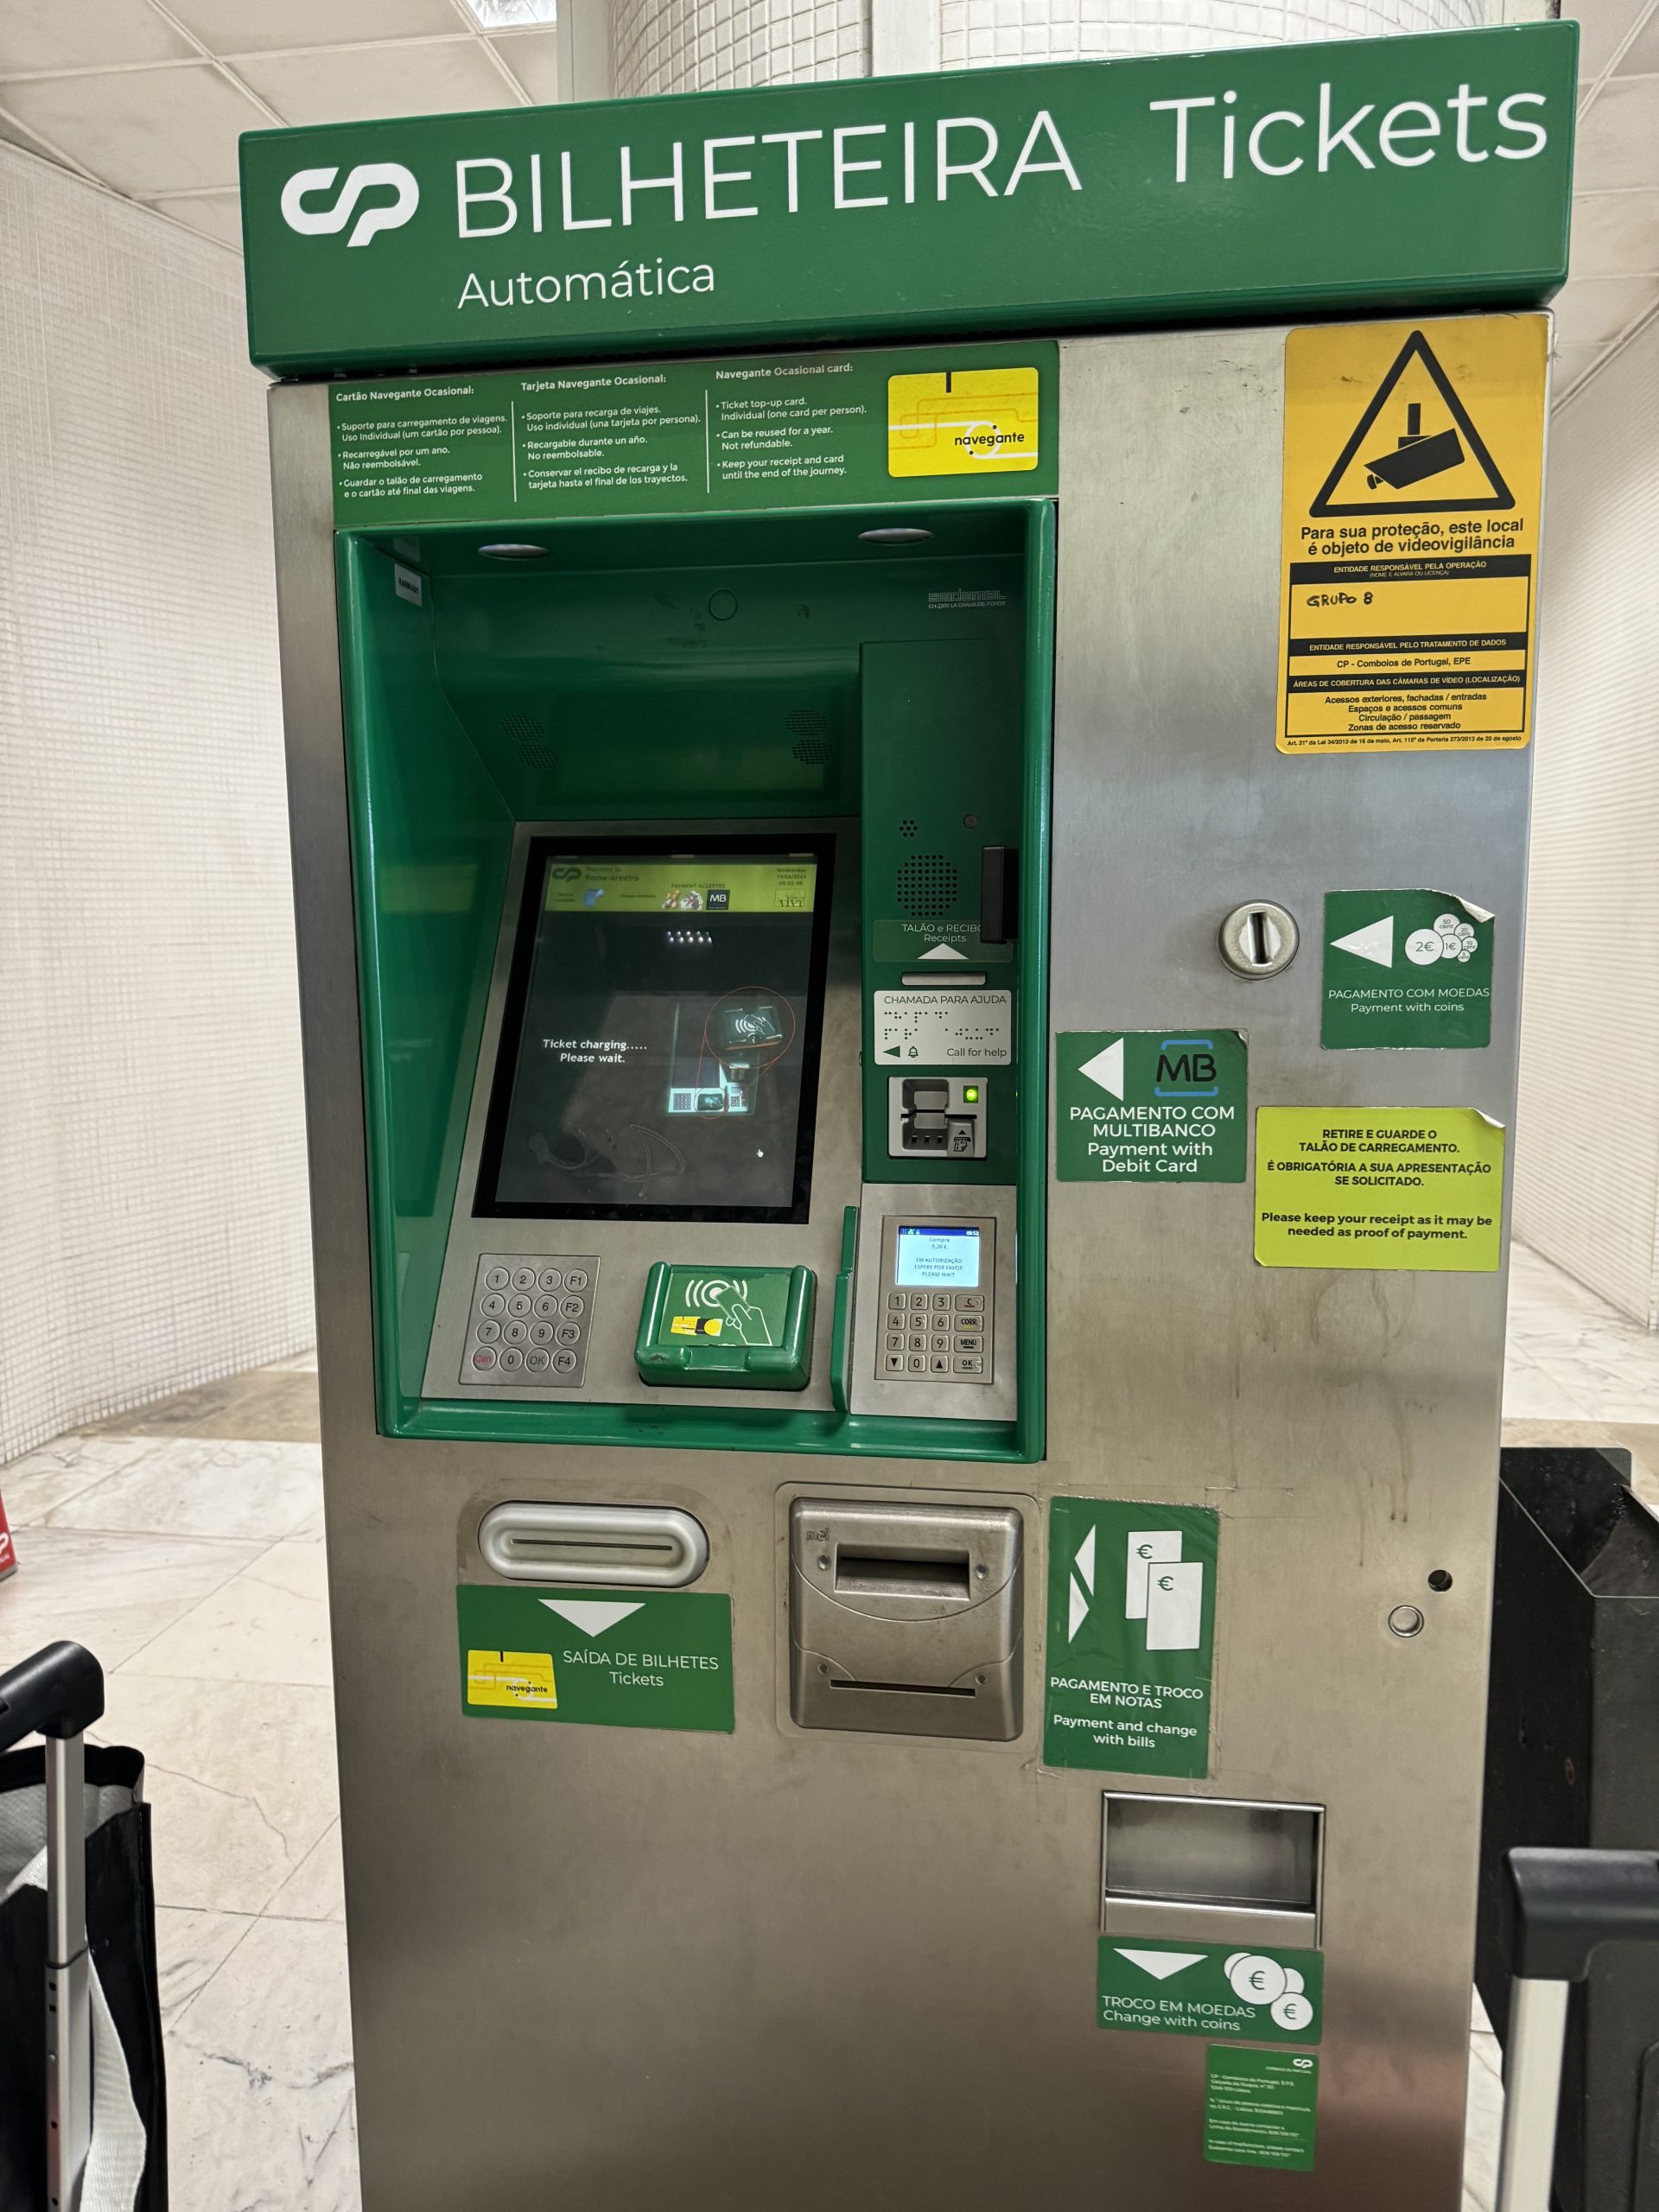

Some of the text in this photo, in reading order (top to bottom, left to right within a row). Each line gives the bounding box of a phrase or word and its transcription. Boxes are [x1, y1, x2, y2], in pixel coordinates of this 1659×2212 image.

[455, 108, 1083, 238] BILHETEIRA
[1149, 82, 1548, 183] Tickets
[458, 257, 714, 308] Automática
[716, 363, 853, 380] Navegante Ocasional card:
[521, 374, 666, 391] Tarjeta Navegante Ocasional:
[336, 385, 474, 402] Cartão Navegante Ocasional:
[721, 397, 807, 410] Ticket top-up card.
[341, 423, 375, 432] Suporte
[377, 422, 395, 430] para
[397, 417, 457, 429] carregamento
[472, 416, 507, 424] viagens.
[528, 439, 576, 450] Recargable
[578, 437, 613, 446] durante
[628, 435, 647, 444] año.
[741, 439, 792, 449] refundable.
[955, 432, 1024, 447] navegante
[343, 448, 397, 459] Recarregável
[399, 449, 413, 458] por
[543, 448, 604, 459] reembolsable.
[343, 458, 421, 470] Não reembolsável.
[722, 454, 843, 469] Keep your receipt and card
[722, 467, 847, 480] until the end of the journey.
[1301, 518, 1523, 539] Para sua proteção, este local
[1308, 535, 1515, 557] é objeto de videovigilância
[1446, 561, 1486, 569] OPERAÇÃO
[924, 934, 966, 944] Receipts
[1415, 941, 1434, 952] 2€
[884, 995, 1007, 1004] CHAMADA PARA AJUDA
[1329, 988, 1490, 999] PAGAMENTO COM MOEDAS
[1351, 1002, 1465, 1014] Payment with coins
[543, 1039, 577, 1048] Ticket
[560, 1053, 625, 1063] Please wait.
[947, 1047, 1007, 1058] Call for help
[1156, 1054, 1217, 1082] MB
[1071, 1106, 1234, 1120] PAGAMENTO COM
[1094, 1124, 1216, 1137] MULTIBANCO
[1323, 1129, 1437, 1139] RETIRE E GUARDE O
[1089, 1141, 1212, 1158] Payment with
[1299, 1140, 1459, 1153] TALÃO DE CARREGAMENTO.
[1103, 1159, 1197, 1173] Debit Card
[1335, 1176, 1424, 1185] SE SOLICITADO.
[1287, 1226, 1334, 1236] needed
[1355, 1228, 1389, 1239] proof
[1391, 1228, 1406, 1237] of
[1408, 1230, 1467, 1240] payment.
[570, 1276, 582, 1286] F1
[565, 1302, 578, 1313] F2
[562, 1329, 575, 1338] F3
[530, 1356, 544, 1365] OK
[558, 1357, 570, 1366] F4
[563, 1649, 719, 1669] SAÍDA DE BILHETES
[609, 1671, 664, 1686] Tickets
[506, 1685, 548, 1694] navegante
[1051, 1677, 1204, 1699] PAGAMENTO E TROCO
[1090, 1693, 1162, 1708] EM NOTAS
[1054, 1714, 1197, 1738] Payment and change
[1093, 1733, 1155, 1748] with bills
[1102, 1995, 1255, 2018] TROCO EM MOEDAS
[1103, 2010, 1240, 2031] Change with coins
